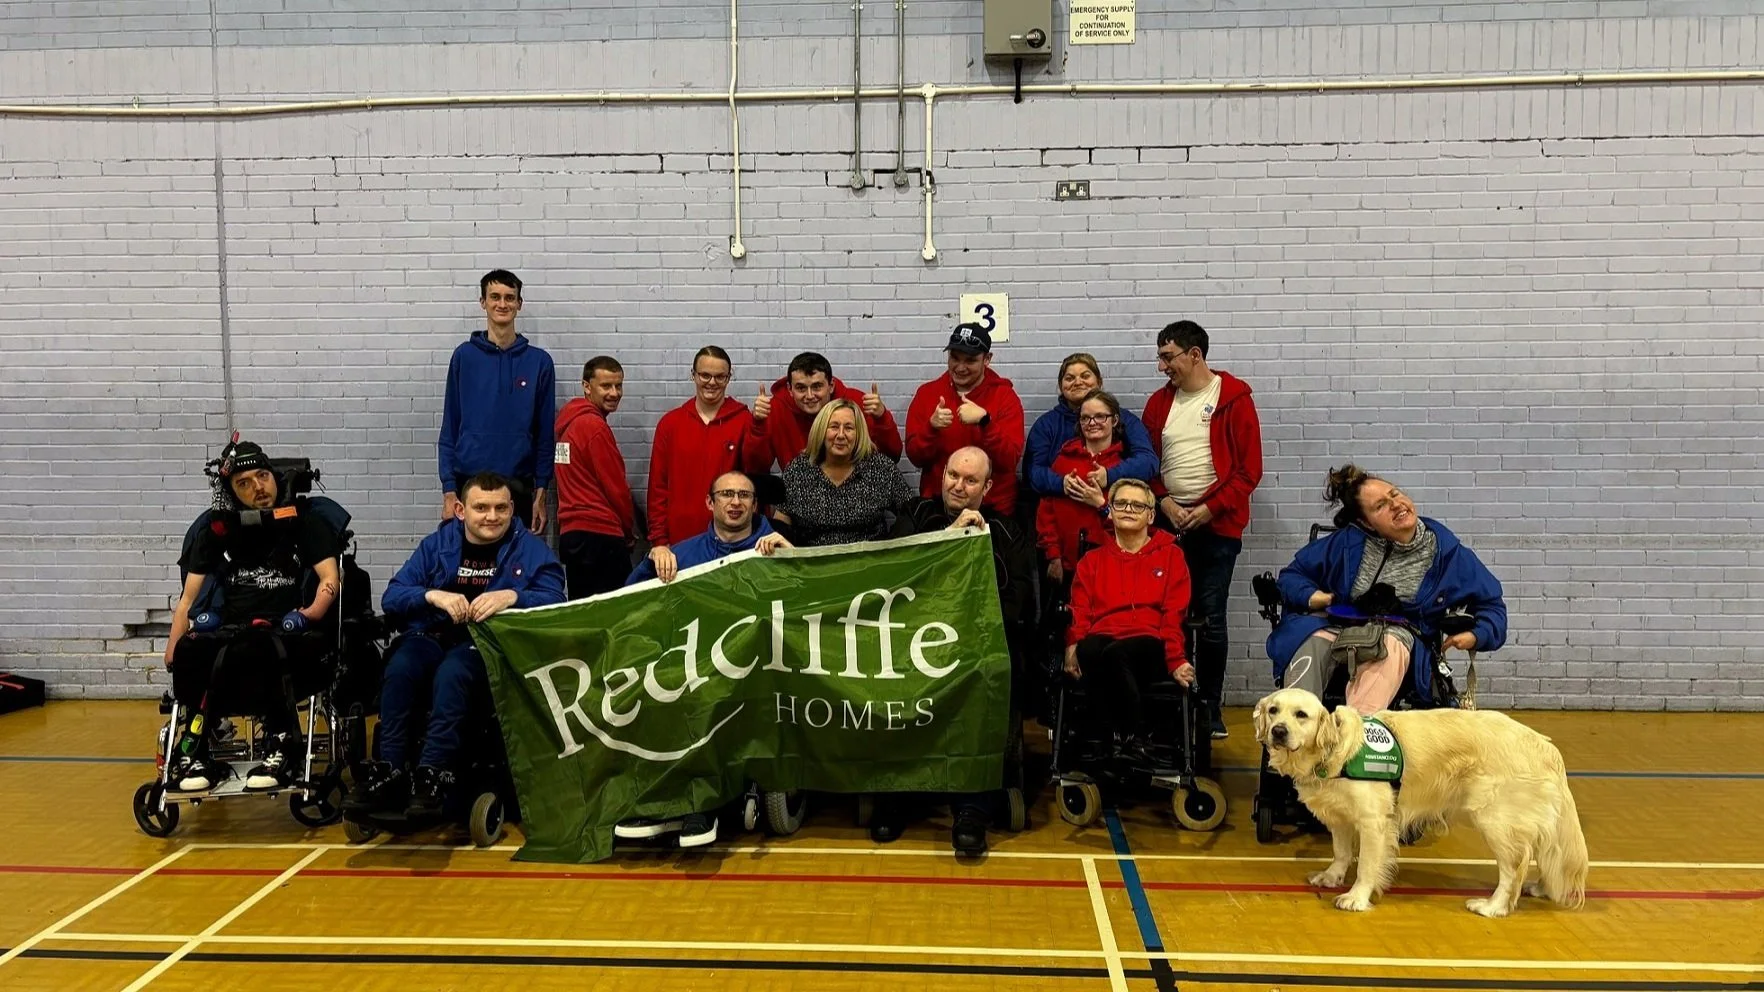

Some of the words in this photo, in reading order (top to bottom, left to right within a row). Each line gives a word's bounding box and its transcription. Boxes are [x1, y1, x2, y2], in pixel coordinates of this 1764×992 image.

[1070, 6, 1109, 14] EMERGENCY
[1110, 5, 1135, 13] SUPPLY
[1113, 29, 1130, 37] ONLY
[974, 303, 996, 332] 3
[524, 587, 961, 761] Redcliffe
[774, 692, 935, 731] HOMES
[1366, 734, 1391, 744] GOOD
